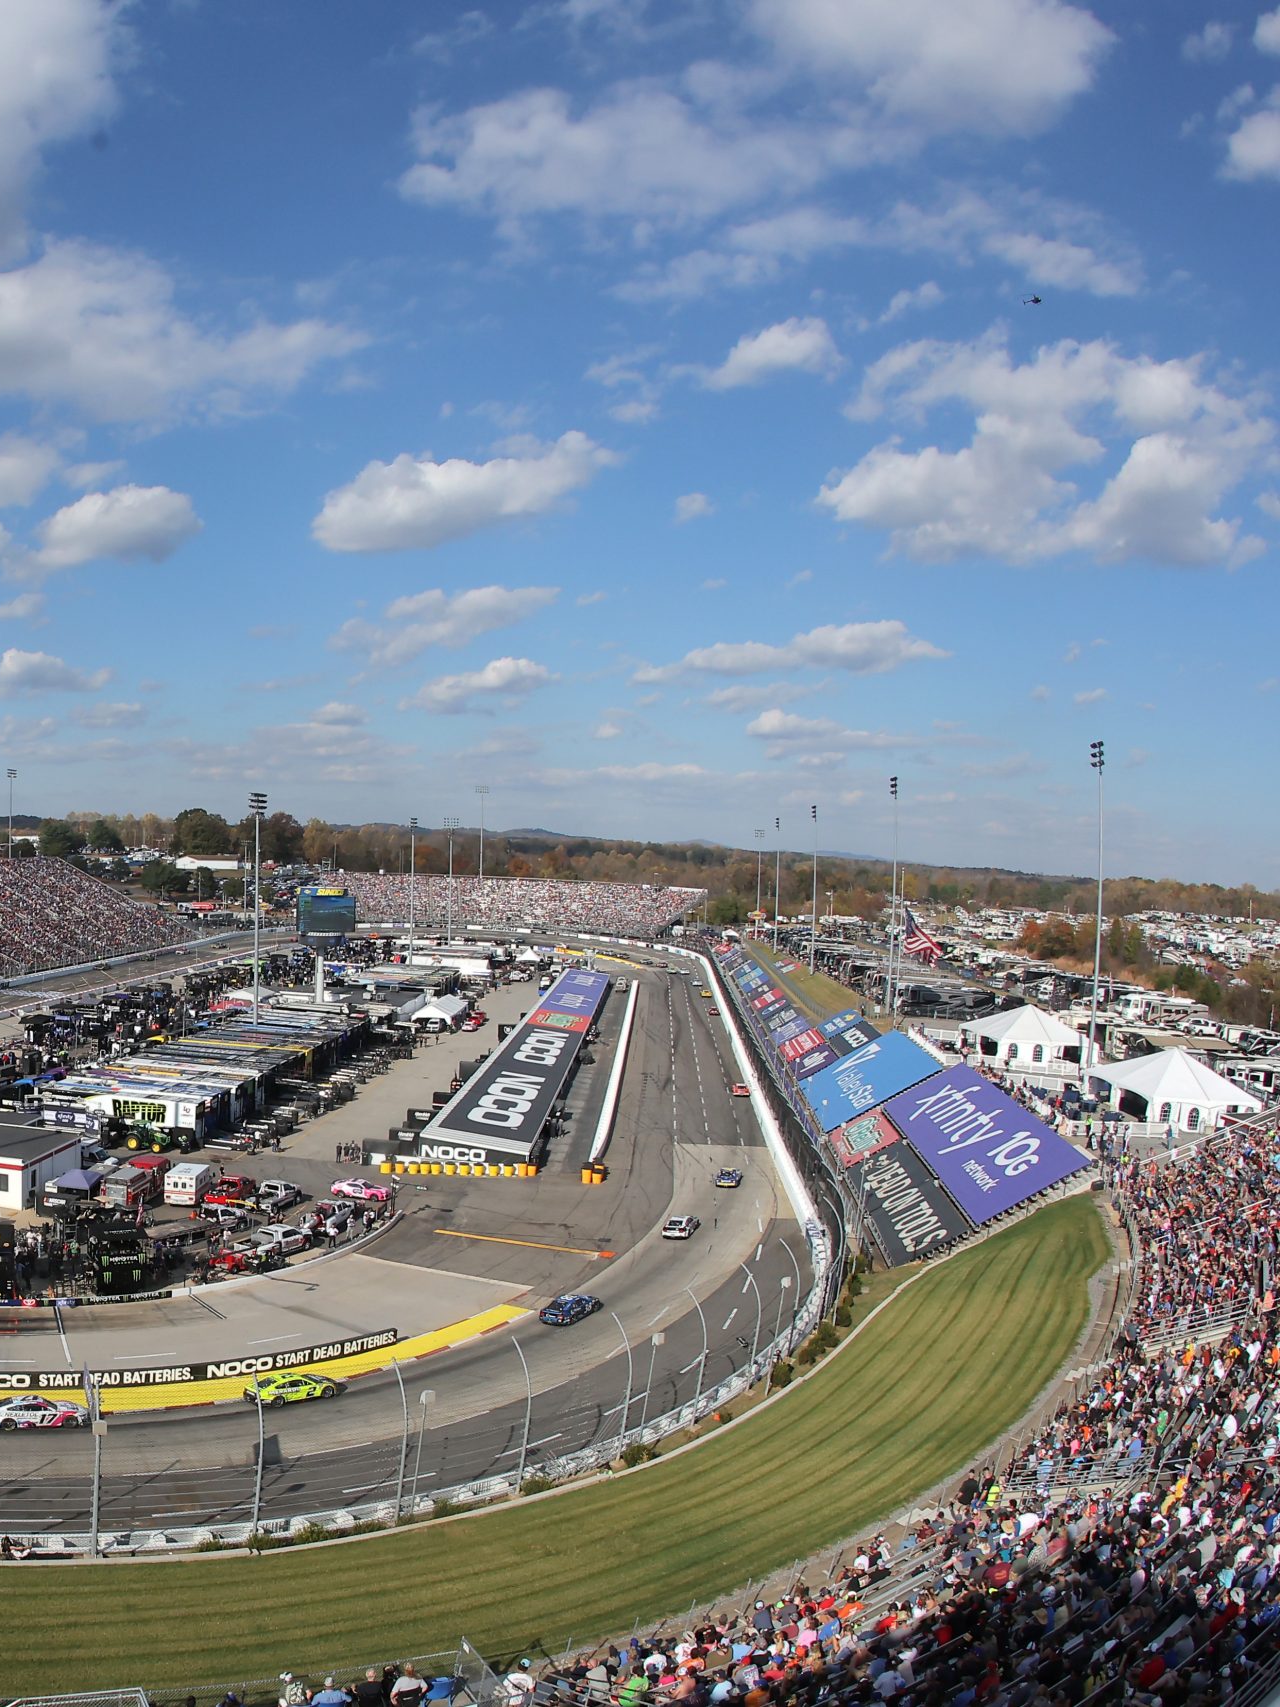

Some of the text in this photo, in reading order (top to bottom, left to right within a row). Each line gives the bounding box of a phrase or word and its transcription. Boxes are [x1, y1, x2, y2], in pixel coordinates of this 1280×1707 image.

[513, 1028, 570, 1066] NOCO
[800, 1051, 829, 1073] ally
[467, 1070, 546, 1129] NOCO
[835, 1066, 876, 1110] ValleyStar
[111, 1098, 167, 1124] RAPTOR
[909, 1083, 1041, 1177] xfinity 10G
[421, 1143, 486, 1162] NOCO
[961, 1159, 999, 1193] network
[865, 1161, 948, 1252] DEAD ON TOOLS
[130, 1291, 160, 1299] MONSTER
[206, 1356, 273, 1379] NOCO
[275, 1349, 311, 1367] START
[312, 1343, 341, 1361] DEAD
[343, 1328, 397, 1354] BATTERIES.
[38, 1373, 81, 1387] START
[123, 1366, 194, 1384] BATTERIES.
[306, 1387, 317, 1396] 2
[39, 1413, 56, 1425] 17
